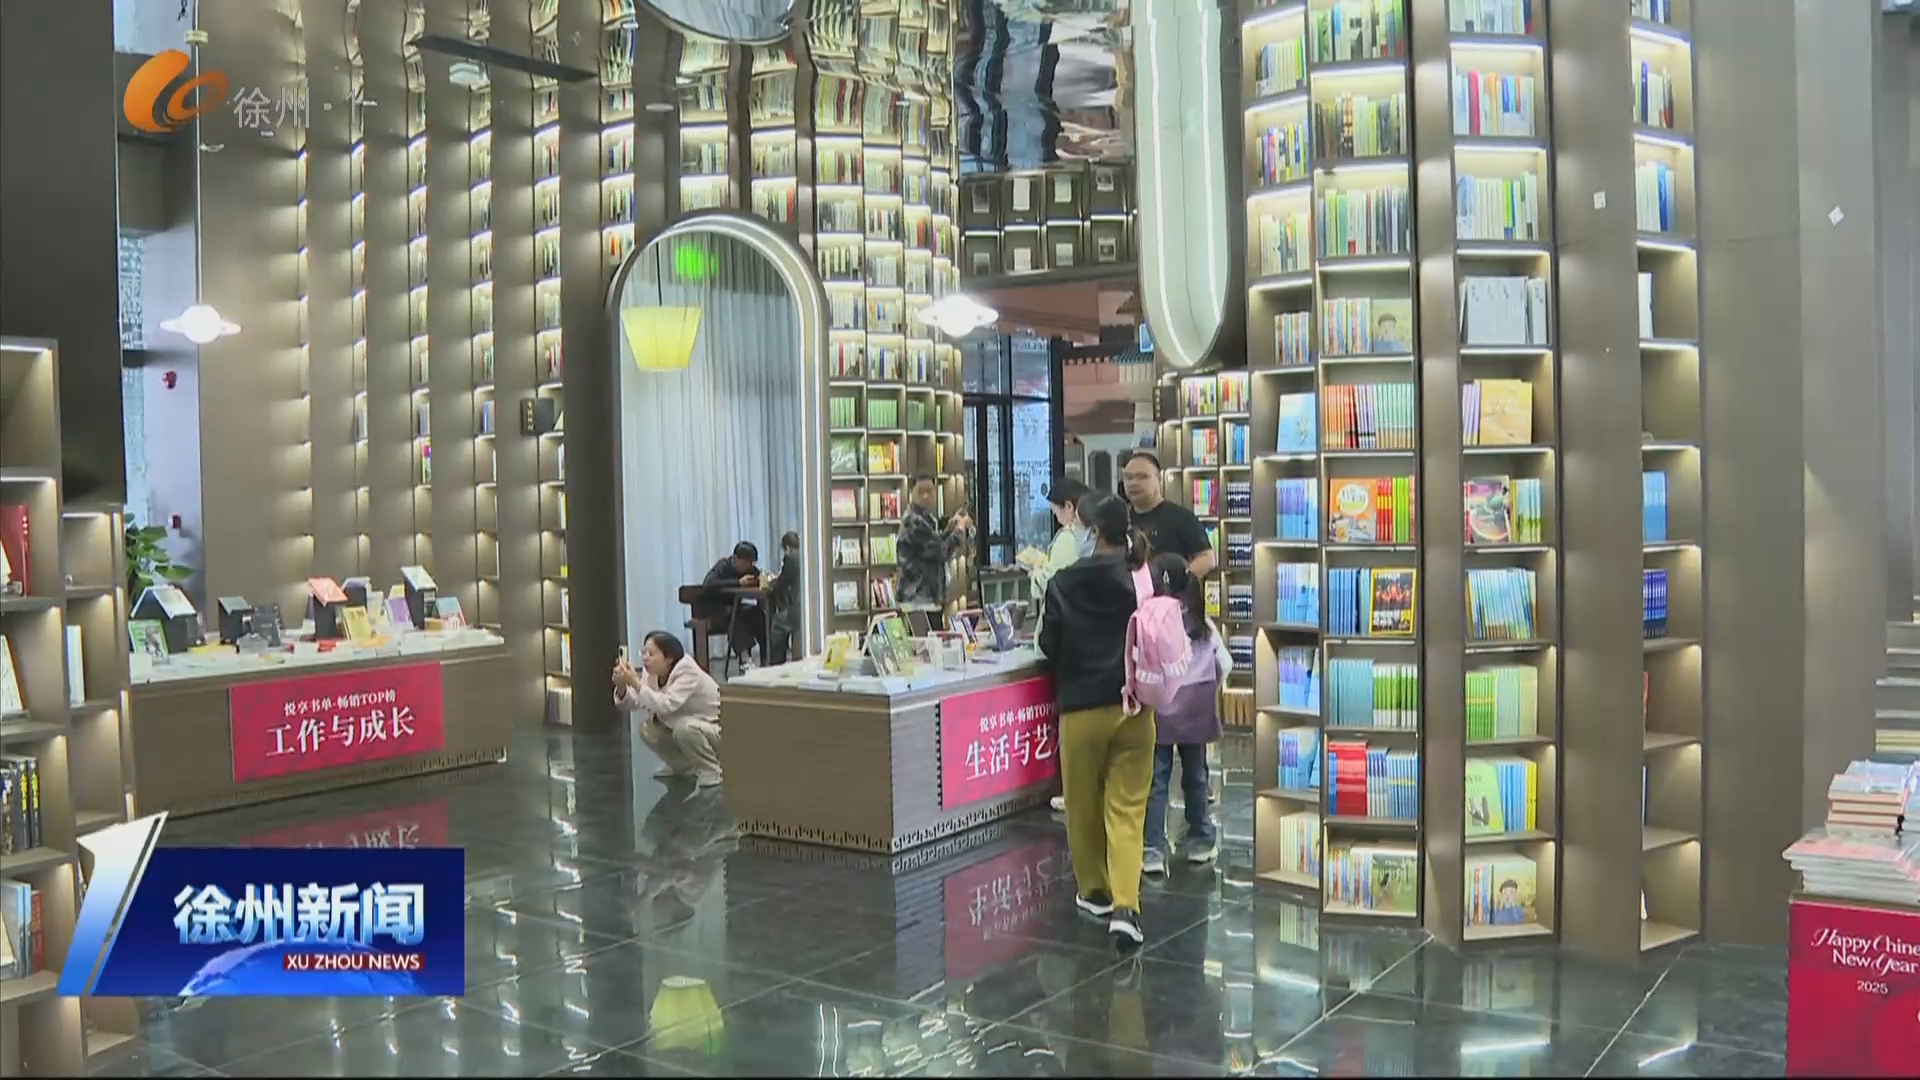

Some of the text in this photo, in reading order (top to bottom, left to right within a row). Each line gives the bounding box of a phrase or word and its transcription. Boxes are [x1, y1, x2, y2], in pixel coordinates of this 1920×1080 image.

[265, 705, 415, 757] 工作与成长
[965, 722, 1060, 781] 生活与艺
[1811, 928, 1871, 953] Happy
[1832, 949, 1919, 977] New Year
[1857, 980, 1888, 994] 2025
